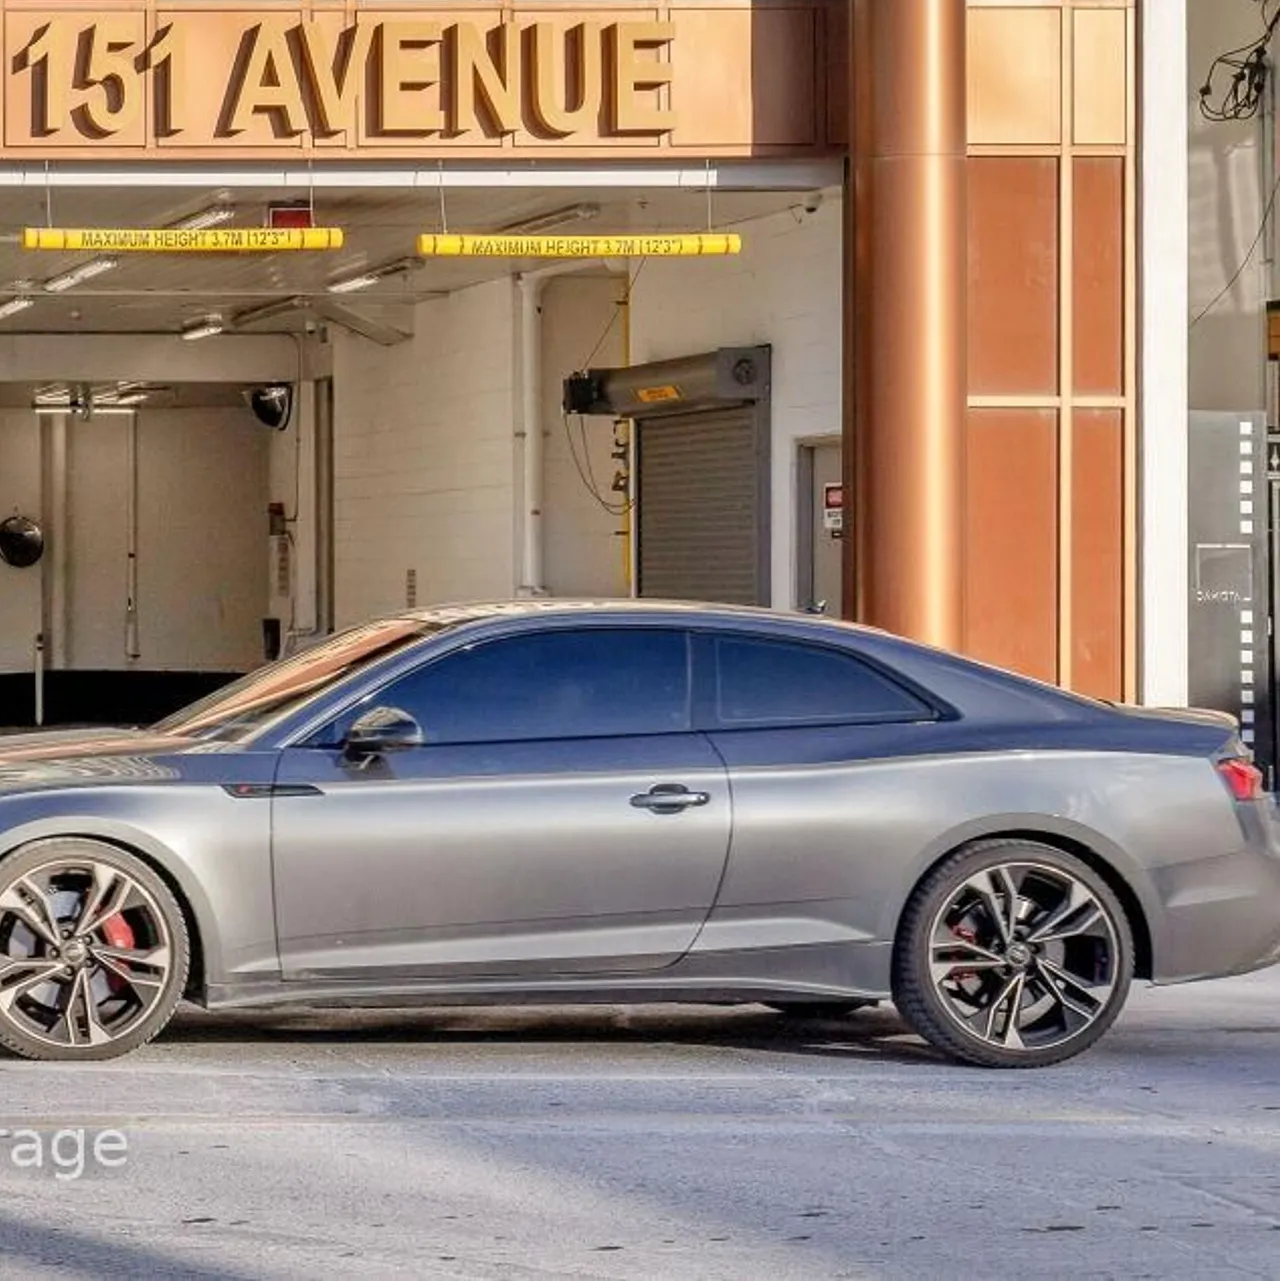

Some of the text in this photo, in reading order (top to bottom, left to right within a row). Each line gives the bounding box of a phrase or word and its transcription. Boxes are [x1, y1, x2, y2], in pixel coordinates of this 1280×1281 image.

[13, 21, 677, 139] 151 AVENUE
[80, 230, 149, 248] MAXIMUM
[154, 231, 208, 248] HEIGHT
[211, 230, 243, 247] 3.7M
[471, 239, 541, 255] MAXIMUM
[546, 238, 599, 255] HEIGHT
